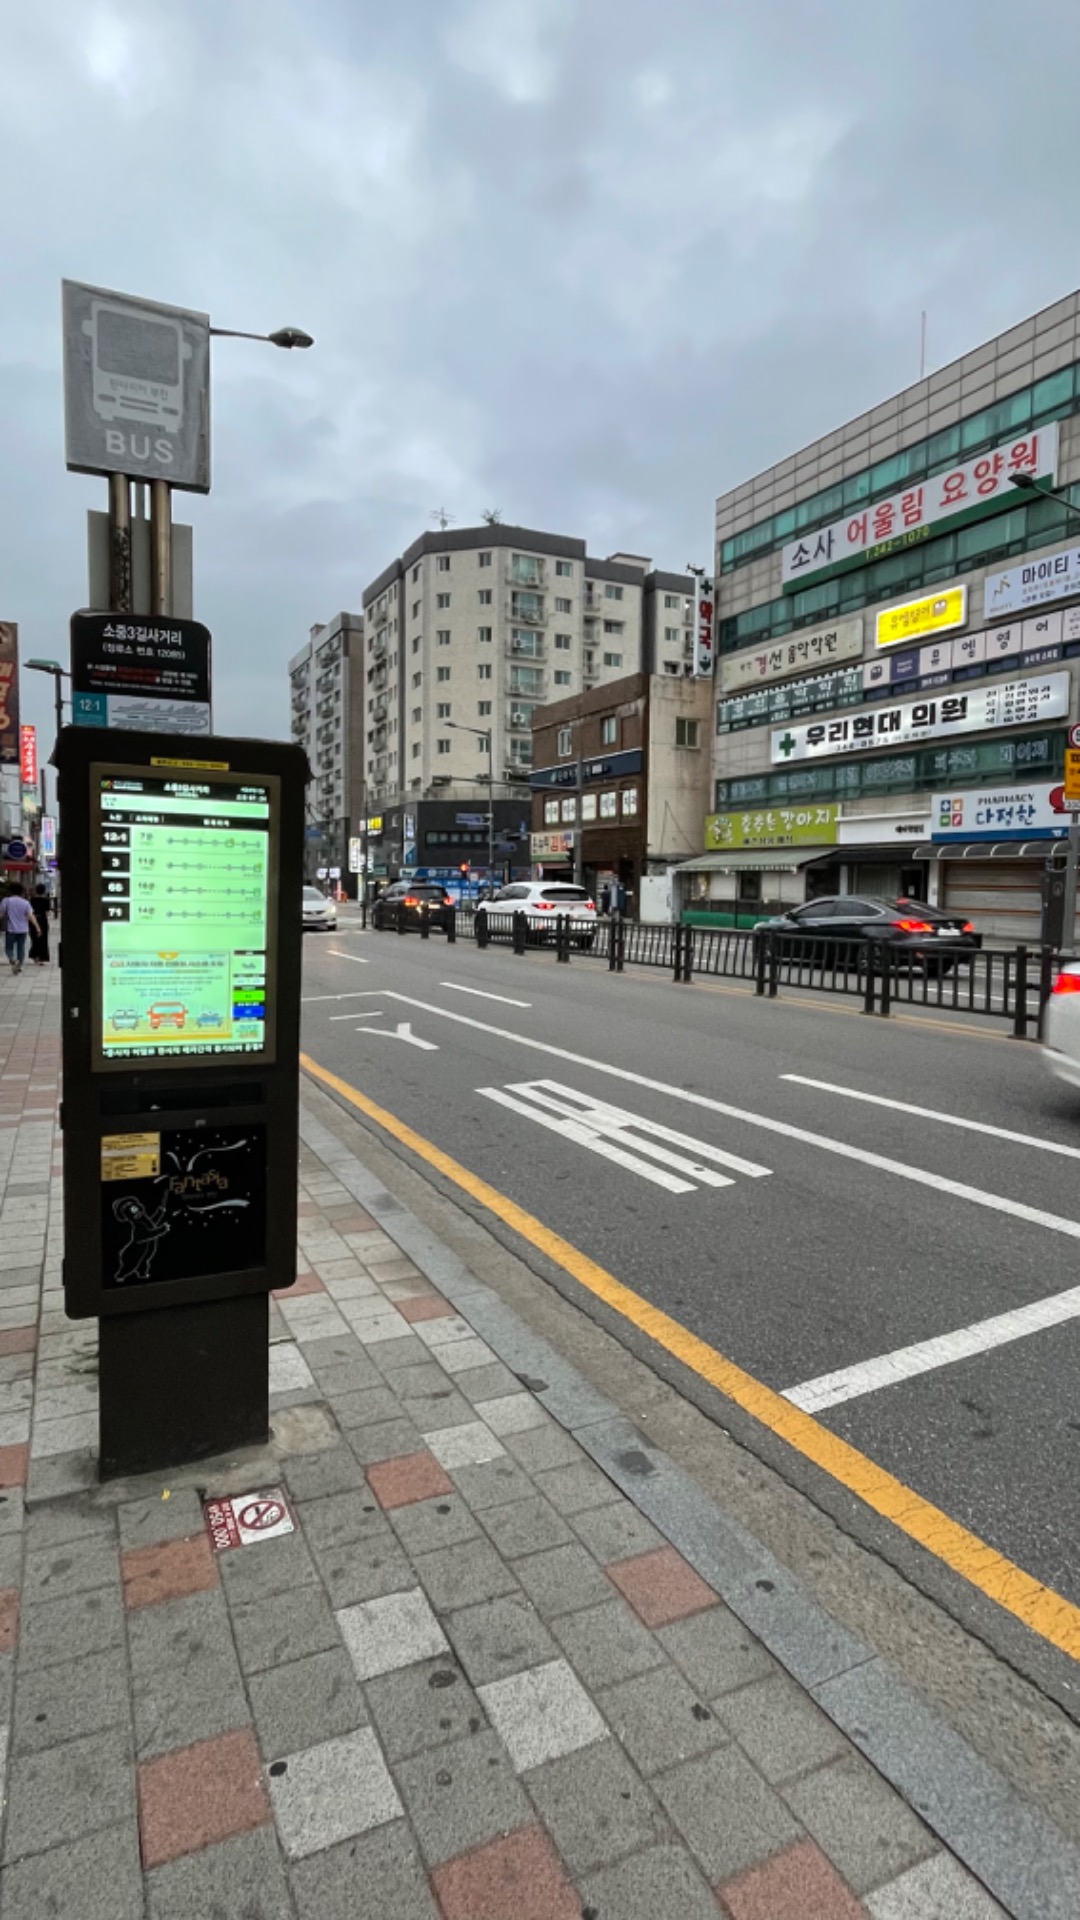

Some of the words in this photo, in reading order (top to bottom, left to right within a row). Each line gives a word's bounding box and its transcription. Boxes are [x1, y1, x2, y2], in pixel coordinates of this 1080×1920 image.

[105, 430, 174, 464] BUS
[789, 529, 835, 571] 소사
[847, 487, 924, 546] 어울림
[938, 434, 1039, 508] 요양원
[1021, 555, 1070, 584] 마이티
[699, 599, 714, 651] 약국
[788, 631, 838, 665] 음악학원
[805, 710, 902, 746] 우리현대
[911, 696, 969, 729] 의원
[975, 804, 1037, 827] 다정한
[977, 793, 1035, 806] PHARMACY
